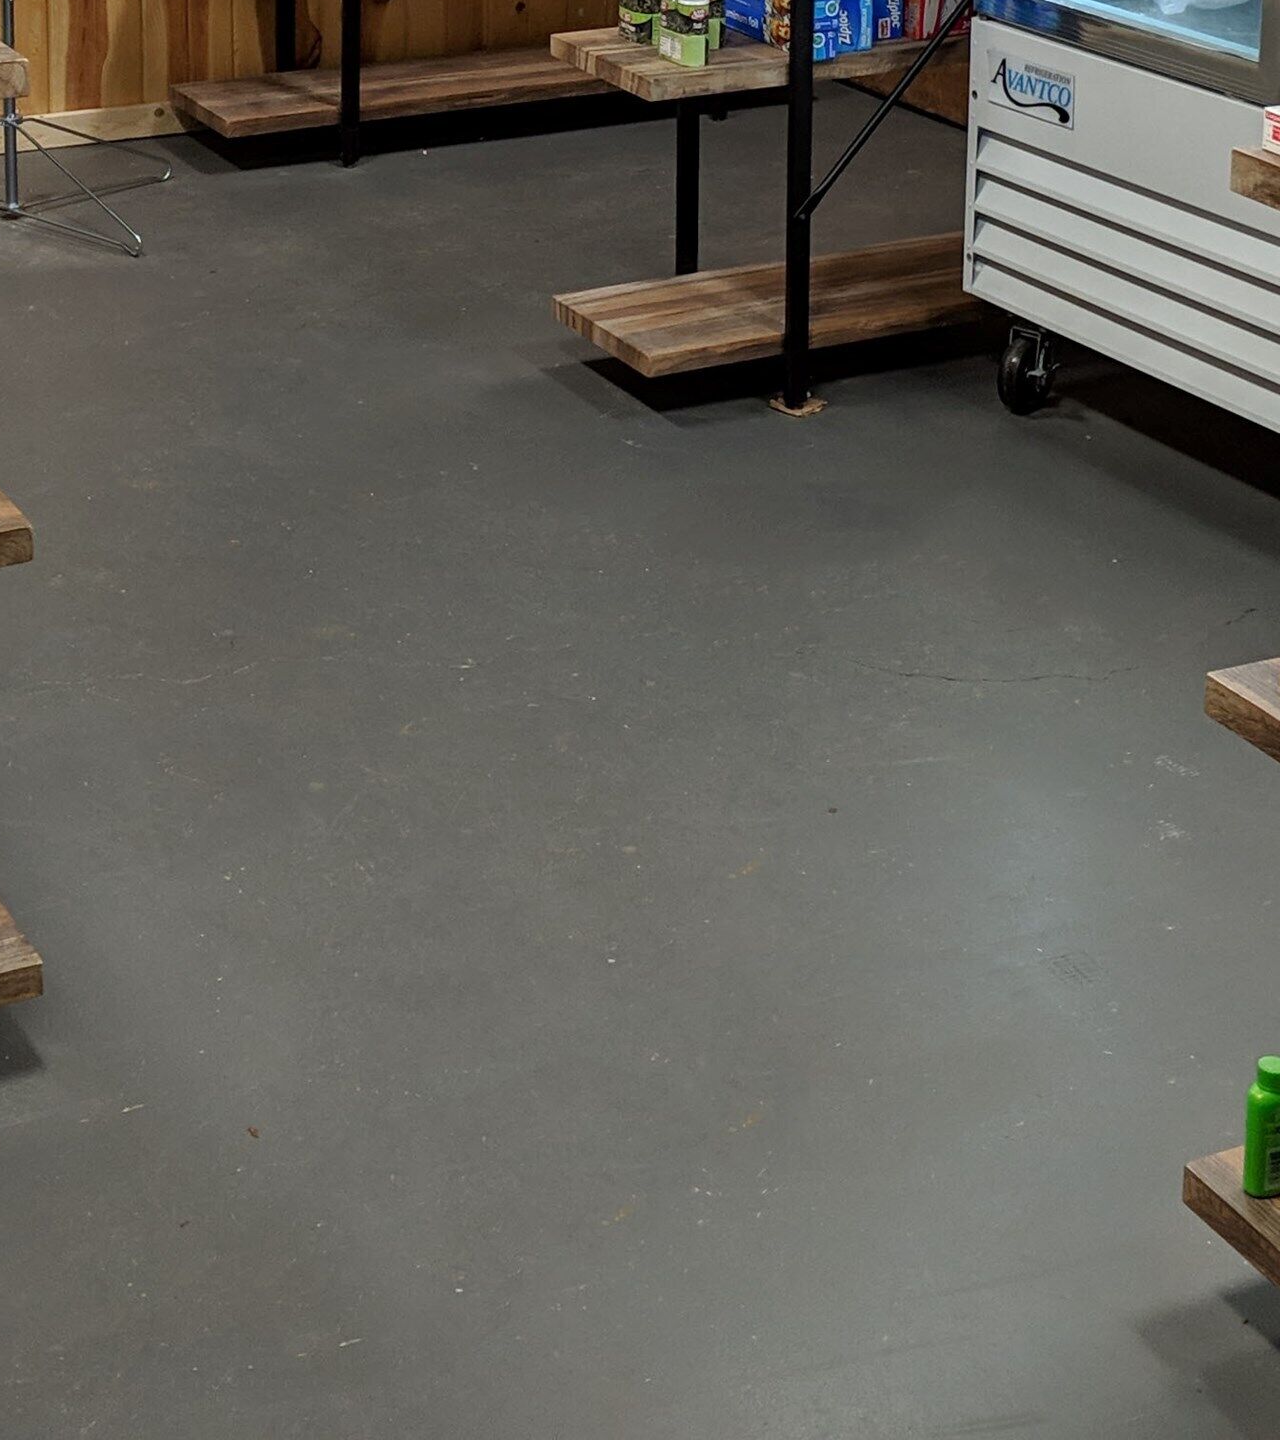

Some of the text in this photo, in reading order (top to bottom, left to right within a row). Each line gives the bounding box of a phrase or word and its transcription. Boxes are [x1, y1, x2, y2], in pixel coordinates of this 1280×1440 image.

[748, 15, 759, 28] foil
[839, 9, 852, 46] Ziploc
[991, 58, 1071, 109] AVANTCO
[1024, 63, 1071, 86] REFRIGERATION
